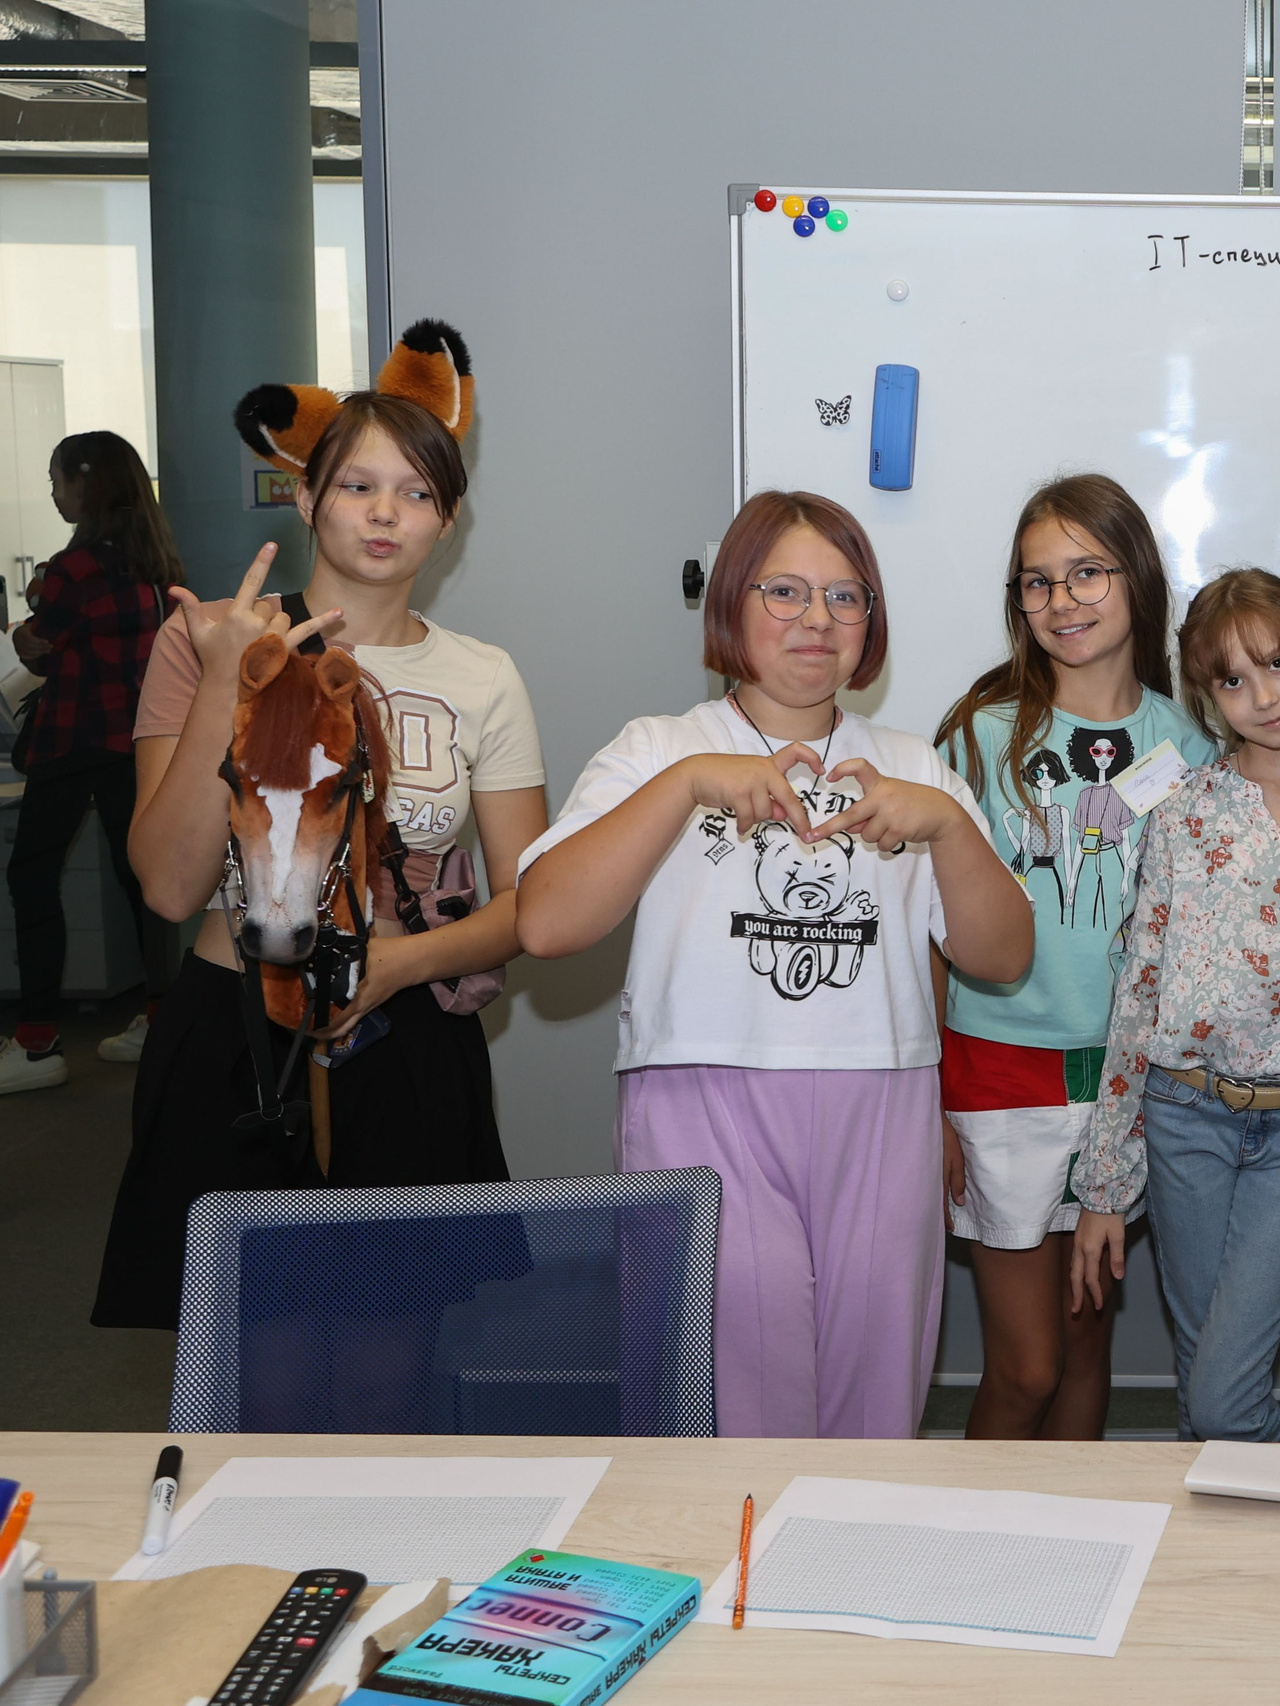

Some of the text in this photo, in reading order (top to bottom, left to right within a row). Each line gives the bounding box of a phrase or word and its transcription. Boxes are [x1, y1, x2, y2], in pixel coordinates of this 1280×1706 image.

[744, 919, 863, 944] you are rocking
[504, 1574, 572, 1591] ЗАЩИТА
[515, 1565, 567, 1579] АТАКА
[650, 1594, 697, 1648] СЕКРЕТЫ
[414, 1632, 546, 1668] ХАКЕРА
[493, 1663, 572, 1686] СЕКРЕТЫ
[605, 1640, 648, 1690] ХАКЕРА
